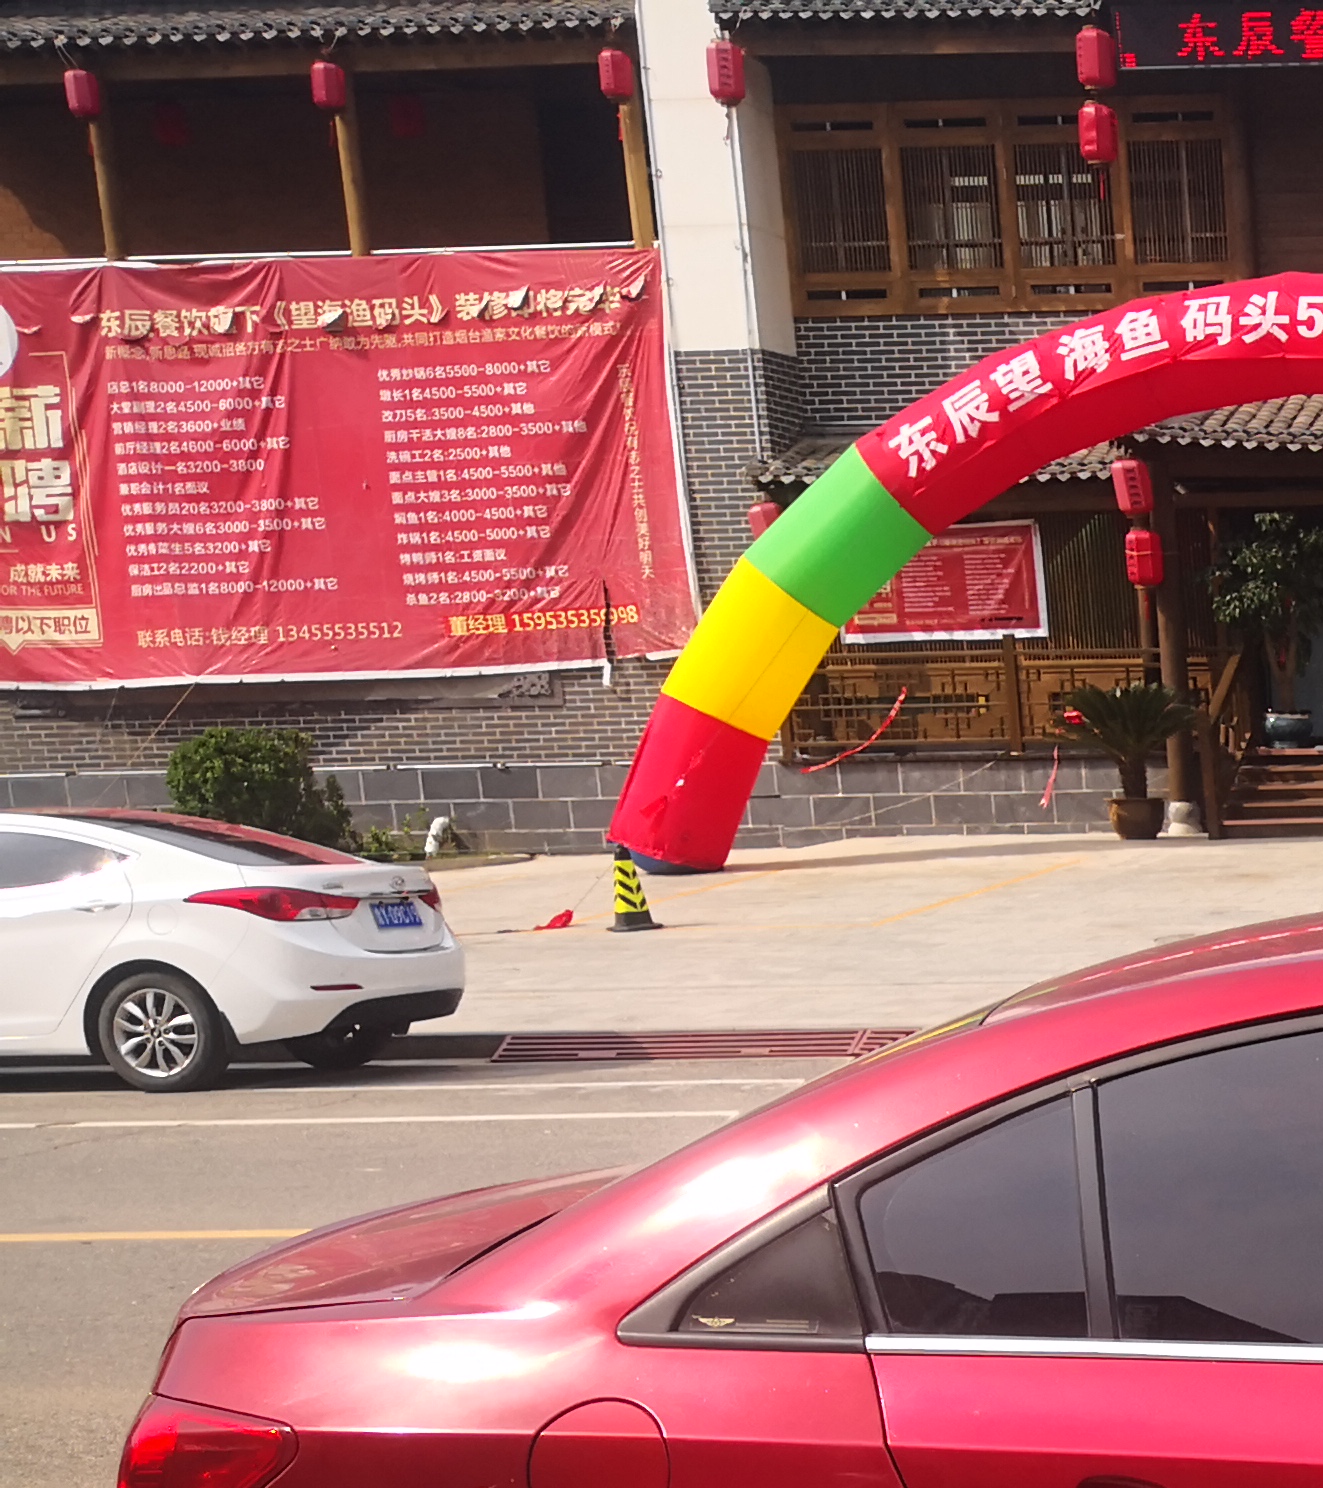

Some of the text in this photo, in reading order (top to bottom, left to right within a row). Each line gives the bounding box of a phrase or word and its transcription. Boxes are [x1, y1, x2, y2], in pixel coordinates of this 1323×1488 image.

[9, 562, 81, 582] 成就未来
[20, 584, 42, 596] THE
[43, 583, 84, 596] FUTURE
[275, 621, 403, 642] 13455535512
